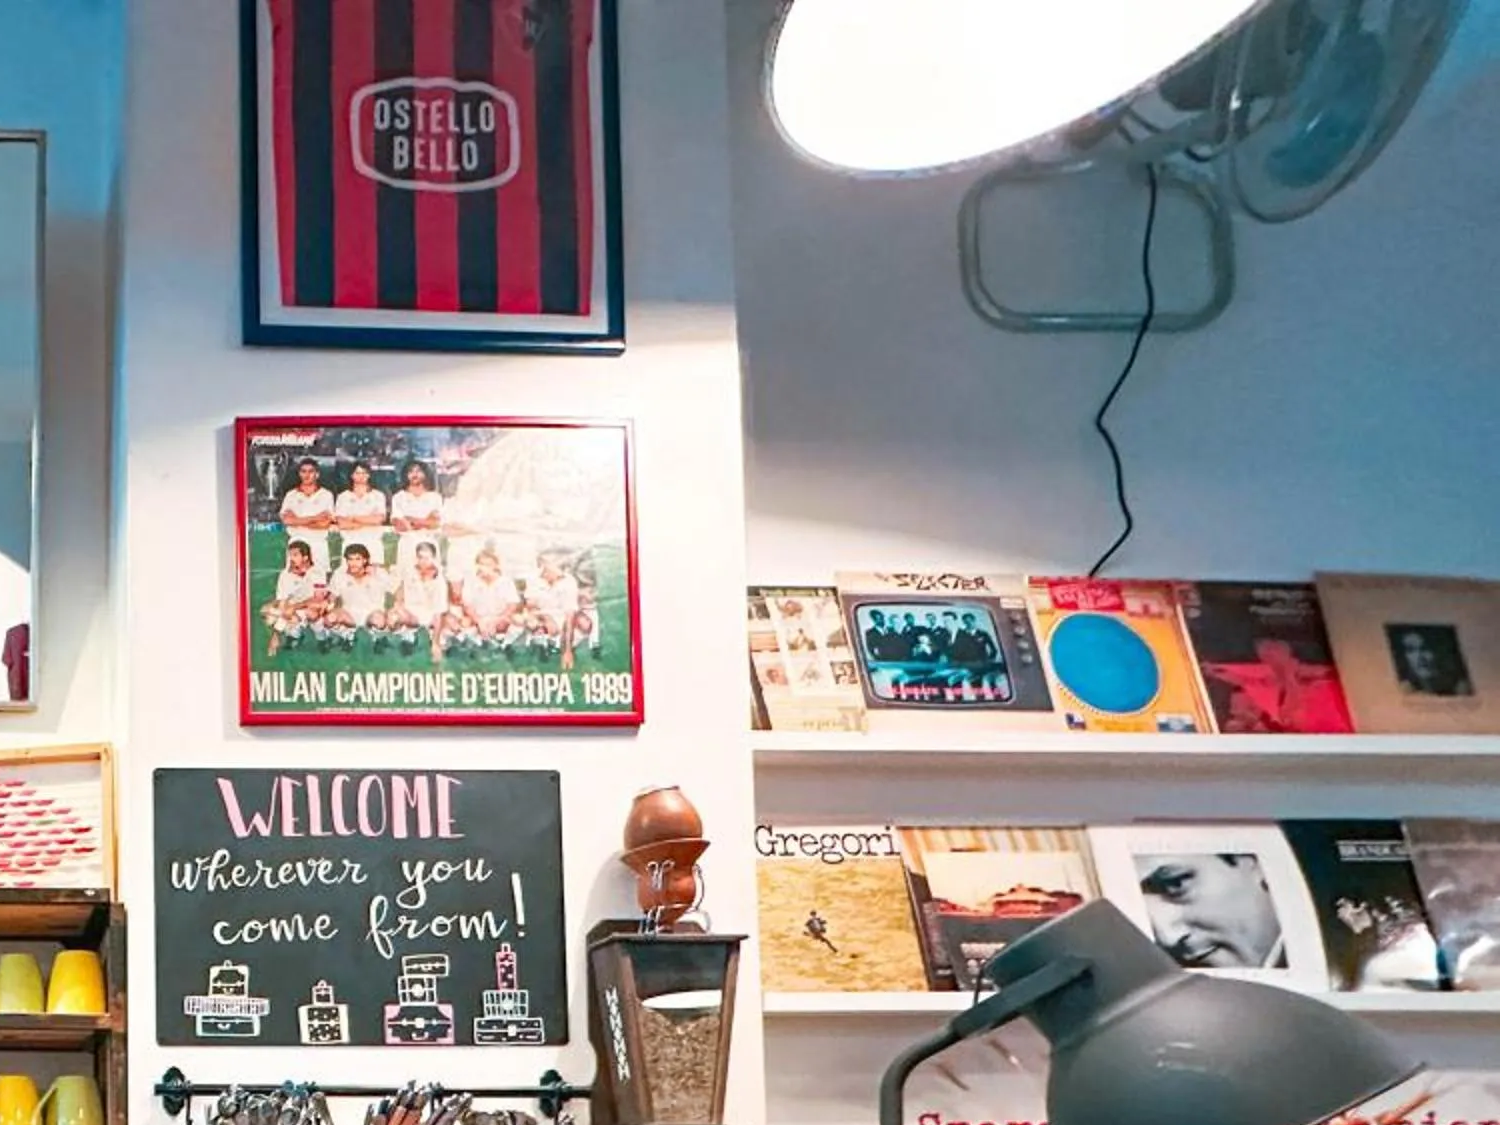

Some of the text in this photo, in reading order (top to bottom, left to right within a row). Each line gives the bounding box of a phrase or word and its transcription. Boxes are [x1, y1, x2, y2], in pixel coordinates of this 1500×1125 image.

[373, 98, 496, 135] OSTELLO
[393, 135, 478, 173] BELLO
[250, 672, 633, 705] MILAN CAMPIONE D'EUROPA 1989
[217, 773, 465, 839] WELCOME
[754, 824, 900, 864] Gregori
[170, 849, 493, 909] wherever you
[212, 910, 339, 945] come
